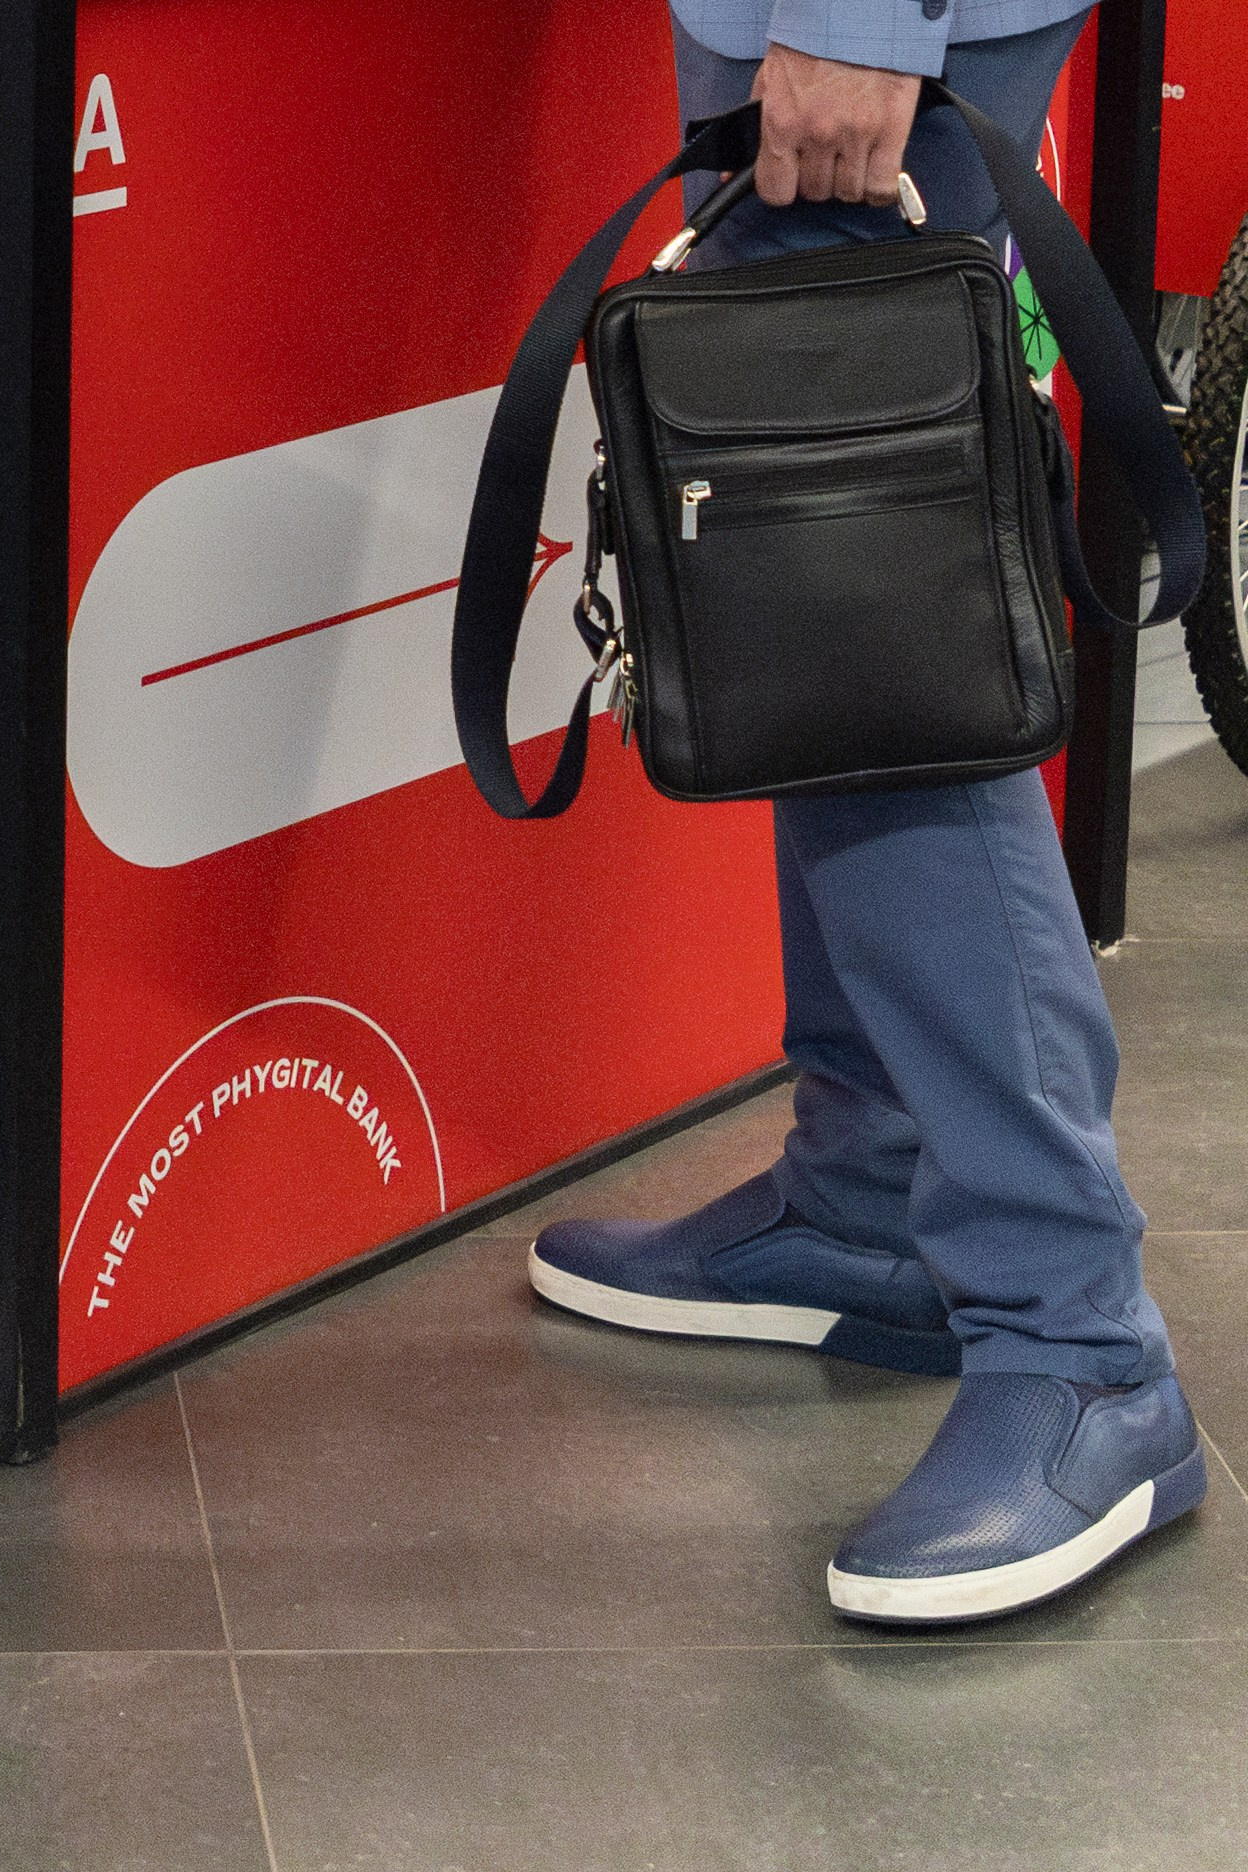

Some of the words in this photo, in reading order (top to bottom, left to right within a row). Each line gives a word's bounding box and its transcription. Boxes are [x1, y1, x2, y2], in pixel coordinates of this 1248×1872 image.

[87, 1219, 135, 1317] THE
[127, 1101, 206, 1218] MOST
[211, 1057, 346, 1119] PHYGITAL
[346, 1085, 402, 1185] BANK
